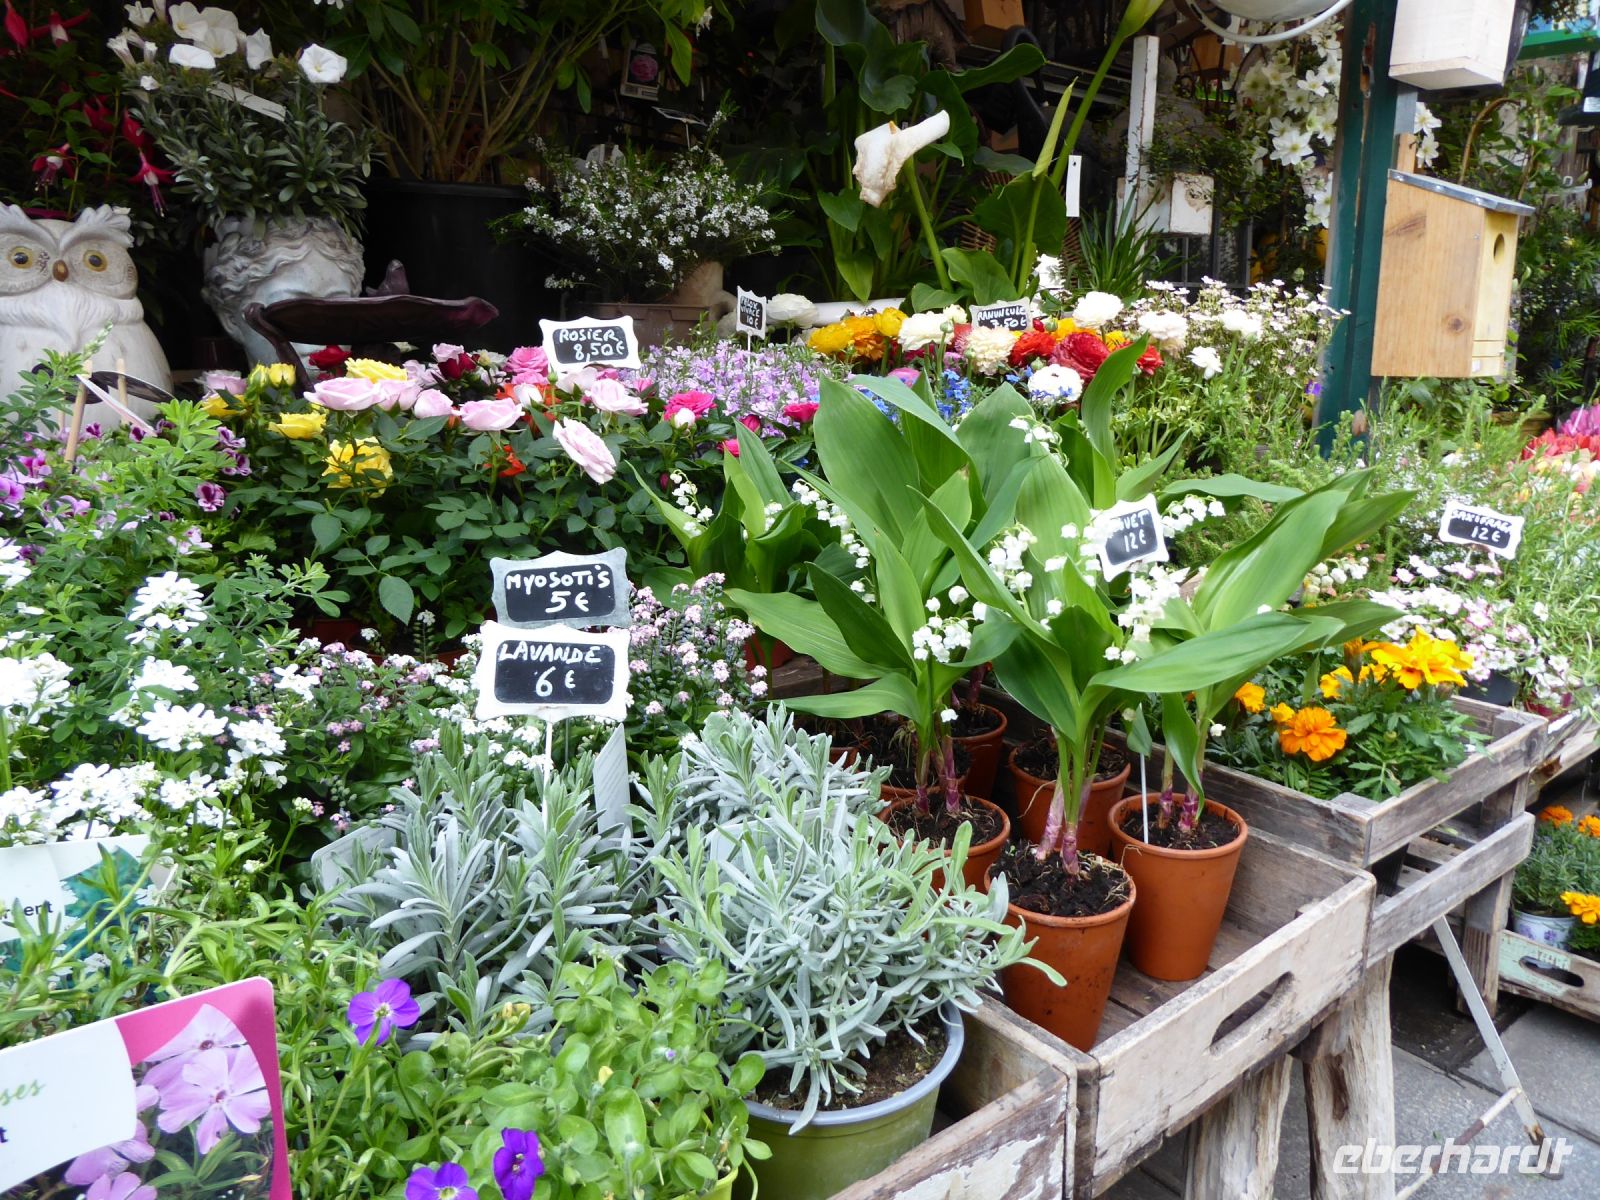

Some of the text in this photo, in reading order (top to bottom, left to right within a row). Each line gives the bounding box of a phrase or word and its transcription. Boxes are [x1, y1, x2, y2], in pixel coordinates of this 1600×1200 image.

[573, 341, 625, 362] 8,50€
[1124, 529, 1147, 553] 12€
[1471, 525, 1502, 543] 12€
[498, 640, 602, 664] LAVANDE
